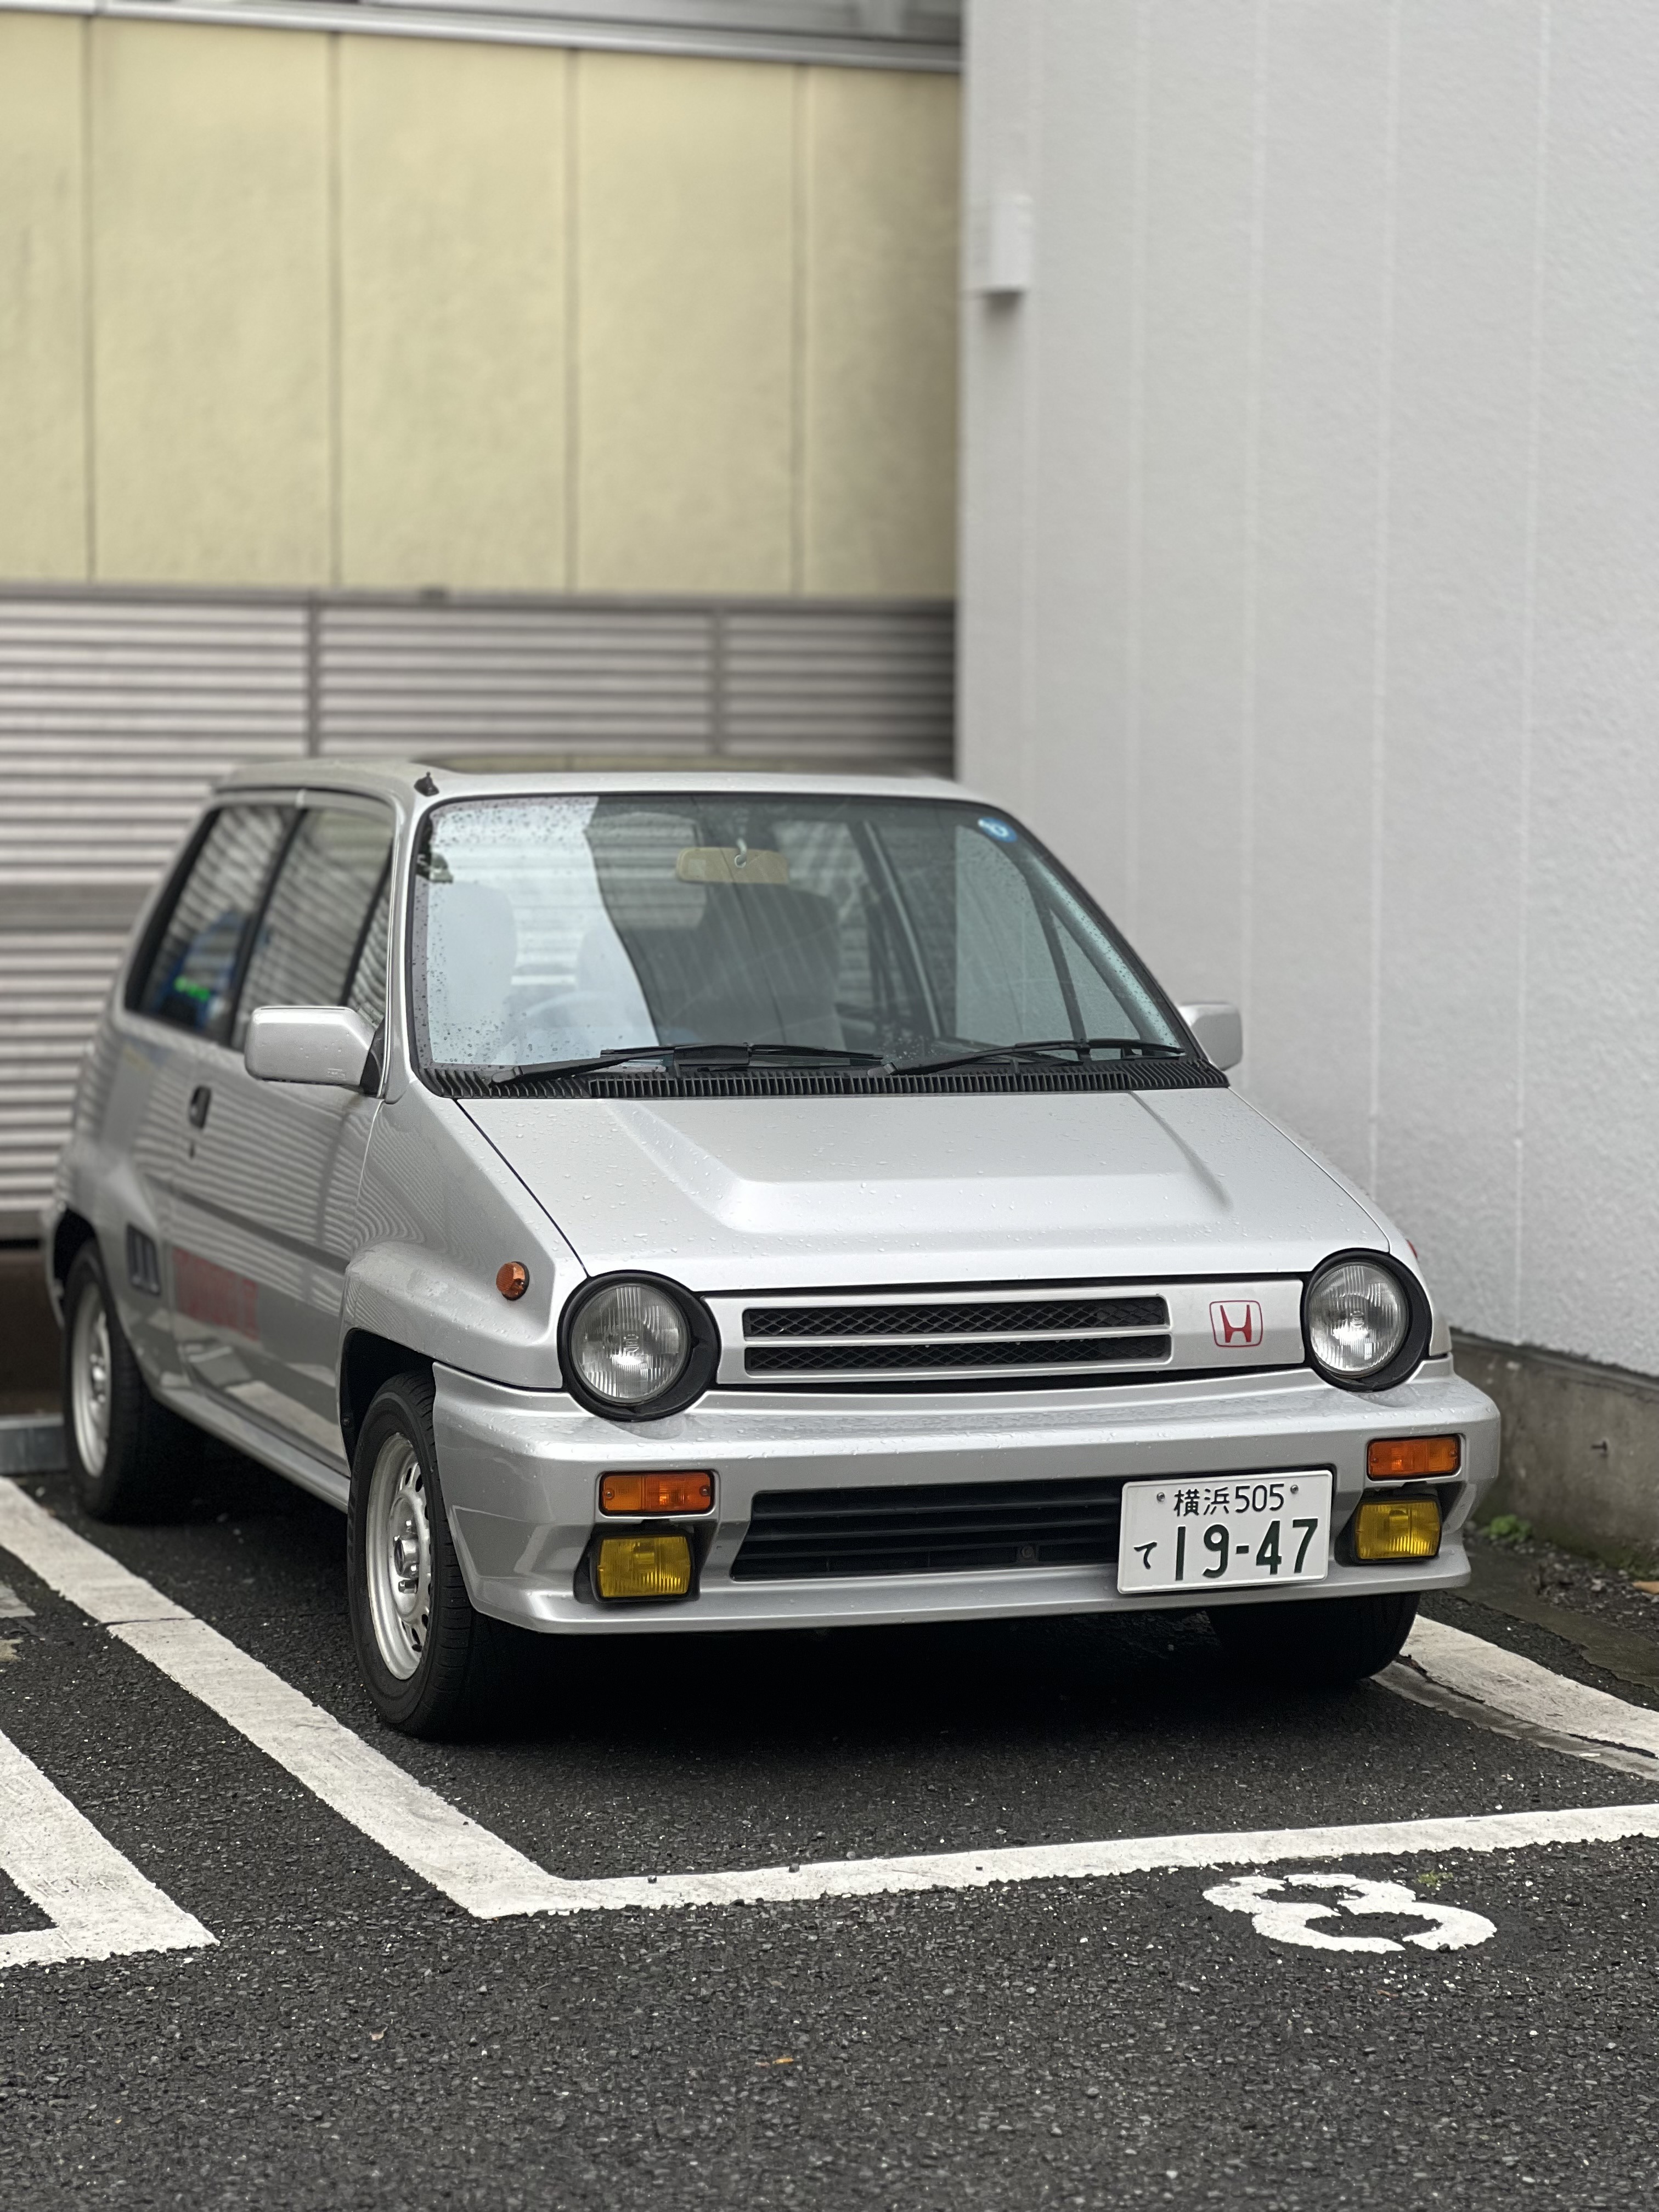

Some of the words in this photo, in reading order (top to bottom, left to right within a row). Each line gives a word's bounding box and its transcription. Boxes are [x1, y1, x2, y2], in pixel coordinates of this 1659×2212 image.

[1220, 1304, 1252, 1343] H
[1133, 1541, 1158, 1570] て
[1175, 1518, 1318, 1581] 19-47
[1203, 1874, 1497, 1954] 8
